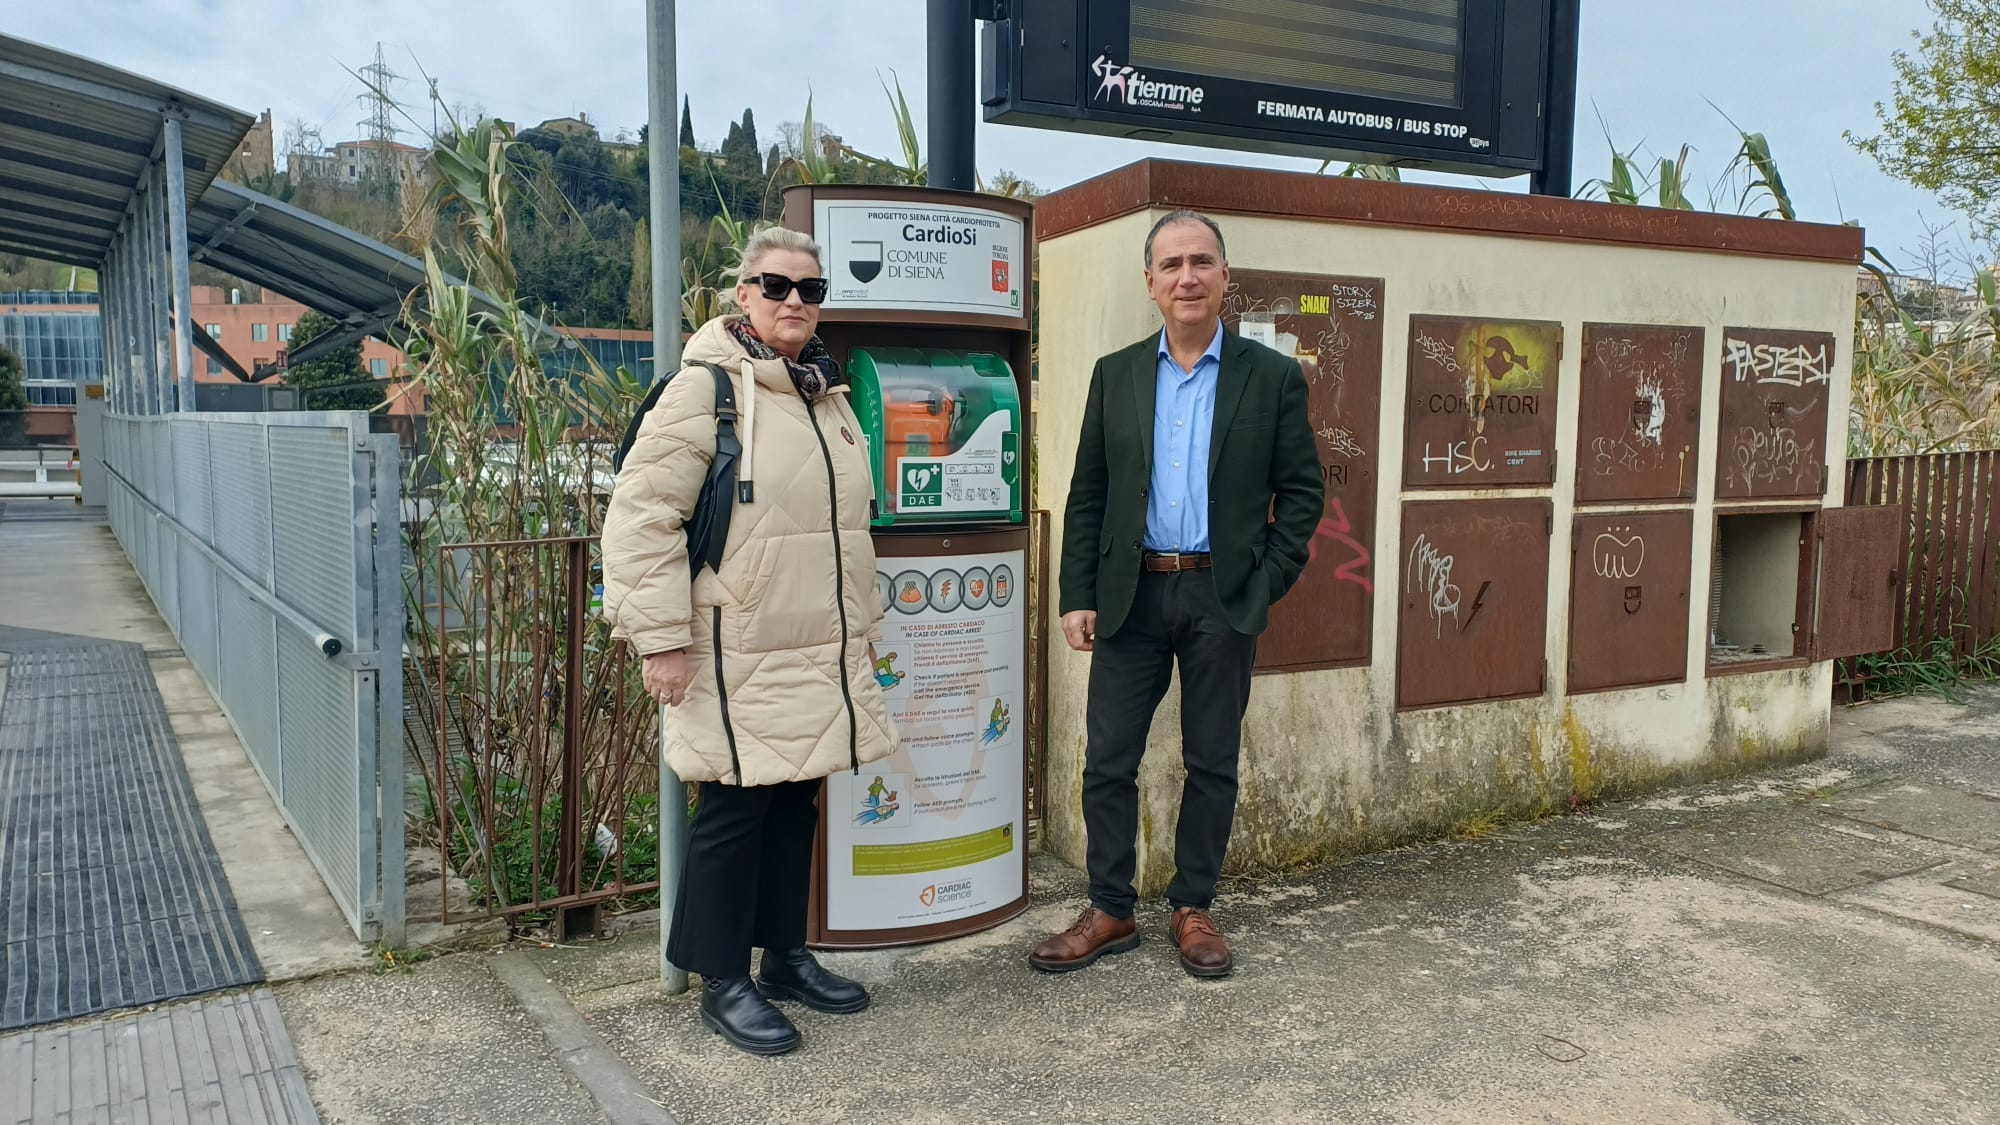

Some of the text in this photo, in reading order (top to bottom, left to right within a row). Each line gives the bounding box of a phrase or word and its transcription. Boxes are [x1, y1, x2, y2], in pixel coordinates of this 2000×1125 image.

[1127, 72, 1204, 105] tiemme
[1257, 100, 1467, 139] FERMATA AUTOBUS / BUS STOP
[868, 212, 1001, 228] PROGETTO SIENA CITTÀ CARDIOPROTETTA
[902, 223, 977, 246] CardioSi
[887, 249, 948, 265] COMUNE
[888, 265, 945, 280] DI SIENA
[1300, 294, 1330, 314] SNAK!
[909, 495, 935, 505] DAE
[959, 620, 985, 628] CARDIACO
[938, 881, 971, 895] CARDIAC
